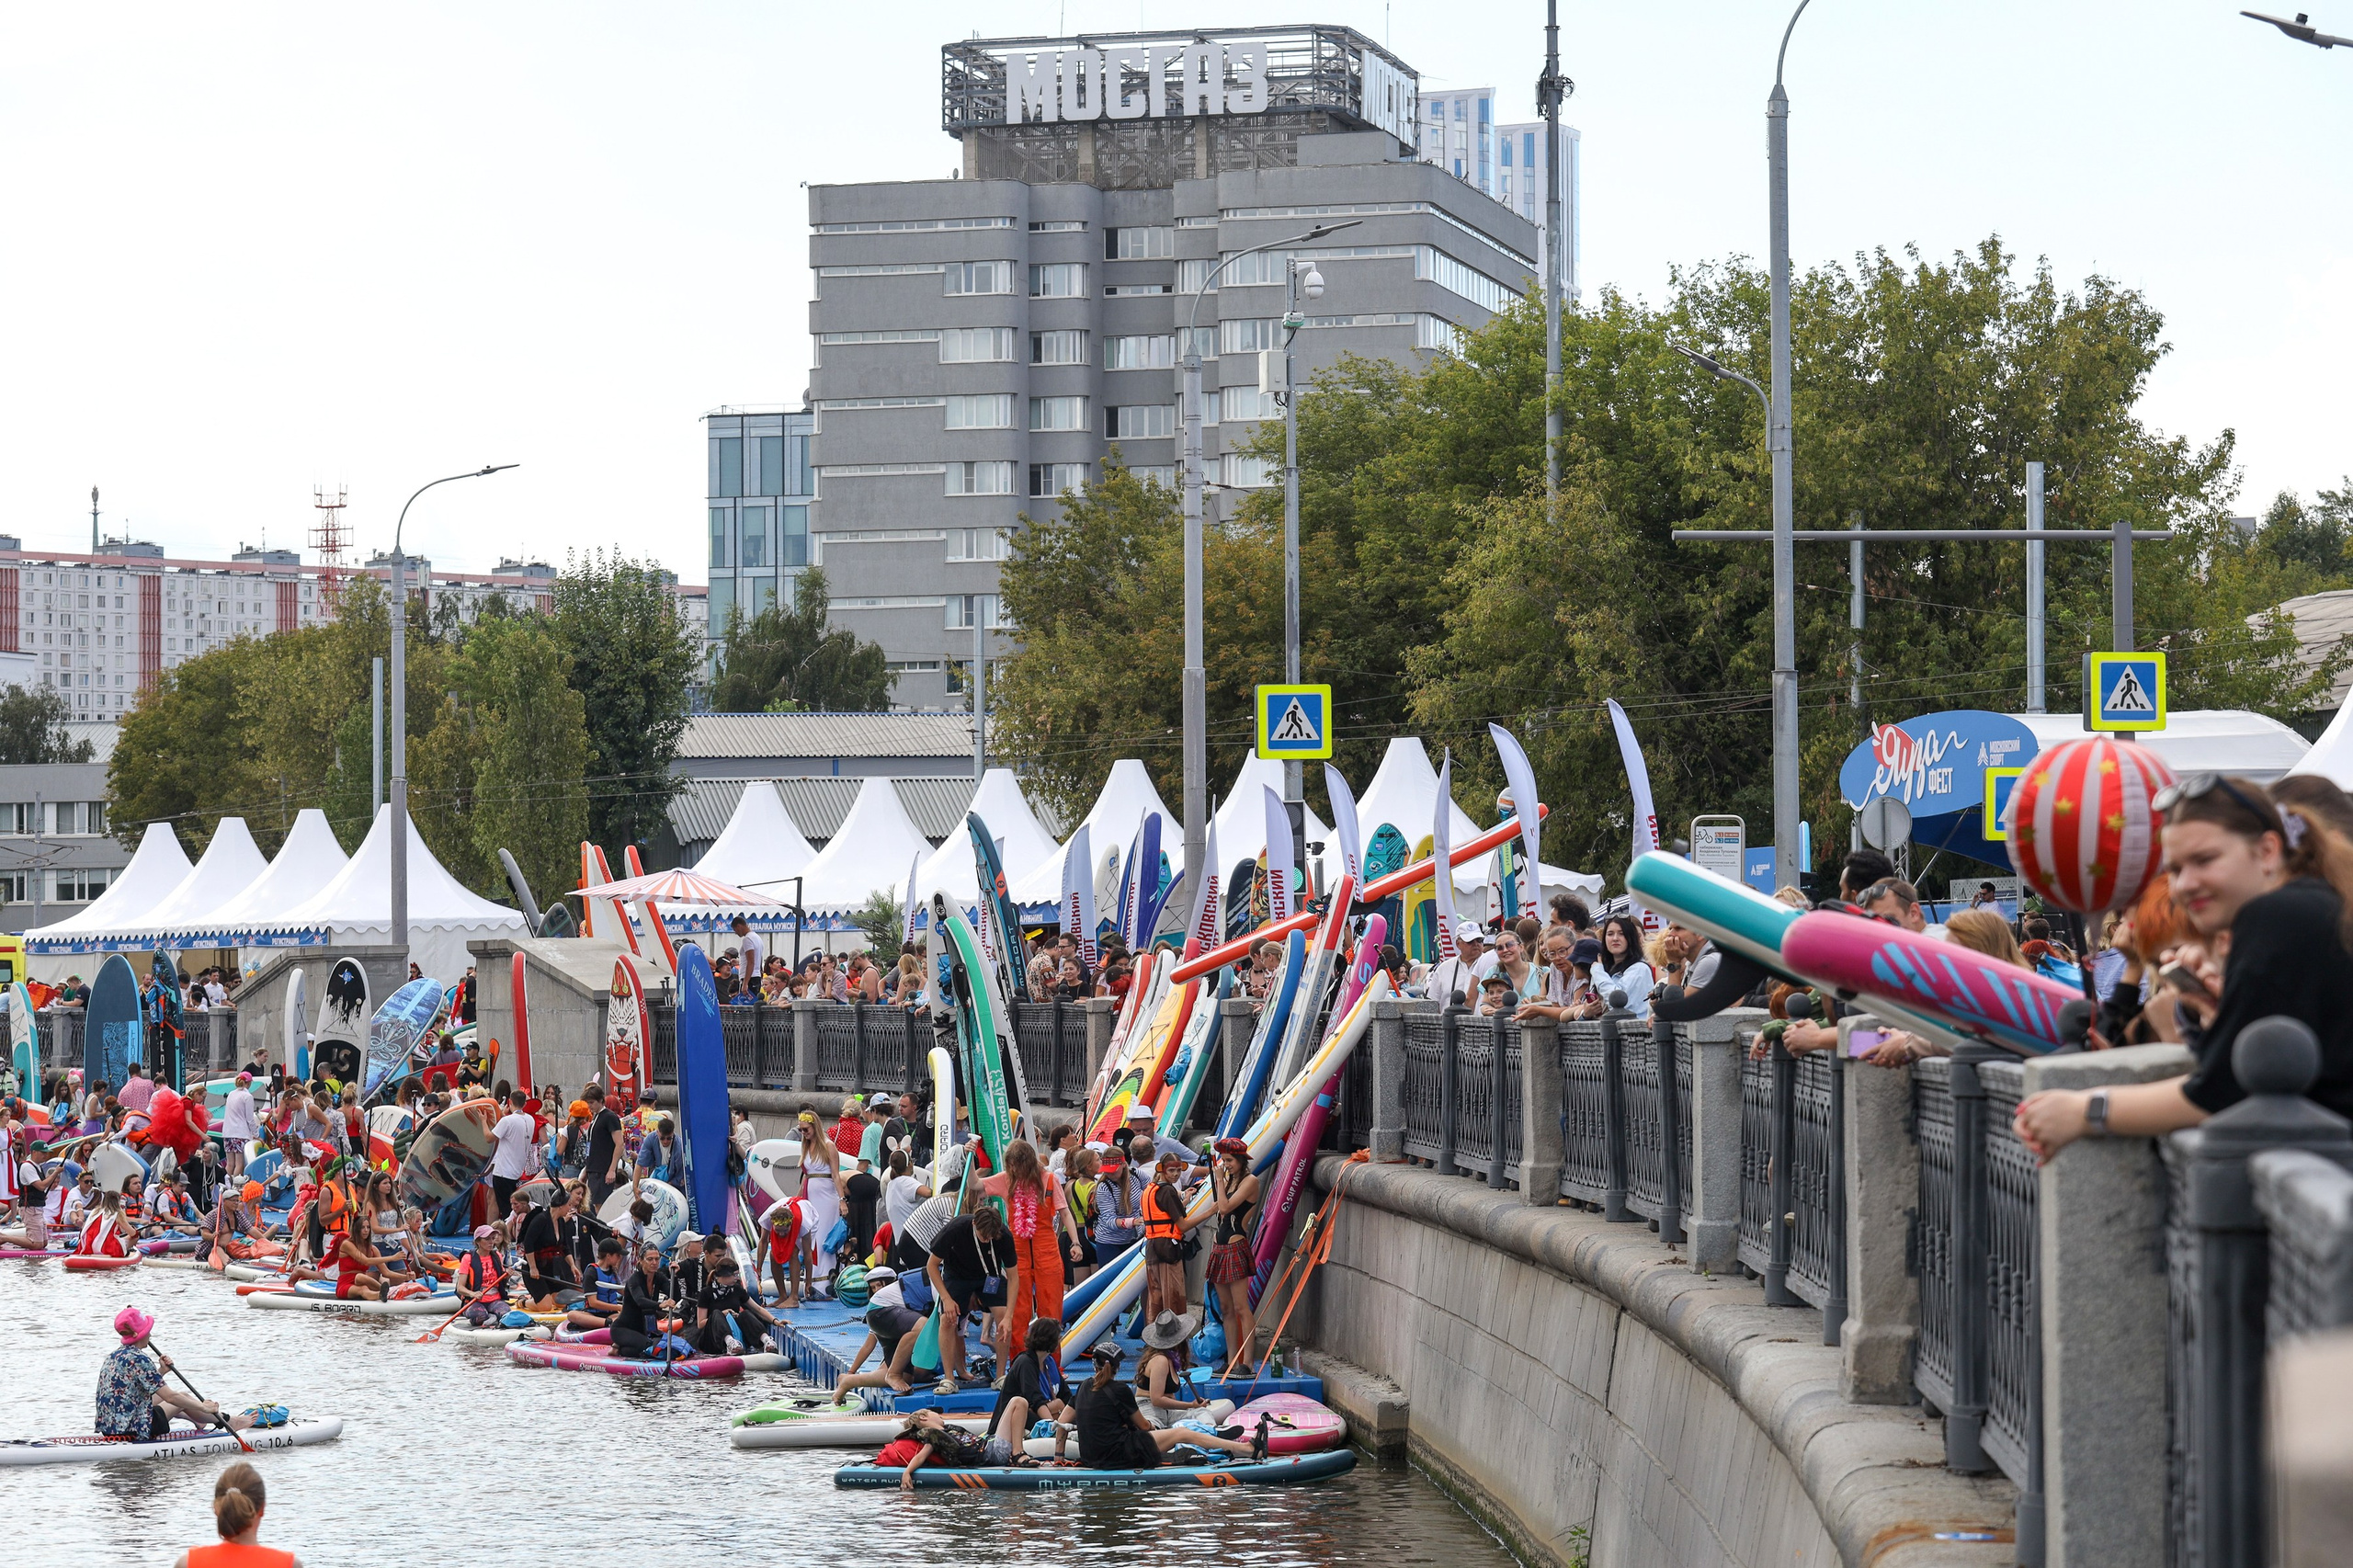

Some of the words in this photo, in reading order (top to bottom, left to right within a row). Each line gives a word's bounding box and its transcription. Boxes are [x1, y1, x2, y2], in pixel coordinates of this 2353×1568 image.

[1006, 41, 1268, 125] МОСГАЗ
[1989, 736, 2020, 754] МОСКОВСКИЙ
[1989, 754, 2005, 766] СПОРТ
[1928, 767, 1953, 795] ФЕСТ
[747, 921, 773, 931] ДЕВАЛКА
[773, 920, 797, 930] МУЖСКА
[1018, 914, 1043, 923] АНЕНИЯ
[1197, 875, 1218, 954] СКОВСКИЙ
[1438, 915, 1457, 957] ПОРТ
[1084, 937, 1096, 969] ПОРТ
[691, 963, 717, 1006] BRADEX
[1286, 1186, 1296, 1201] SUP
[1291, 1158, 1307, 1186] PATROL
[203, 1439, 263, 1453] TOURNG
